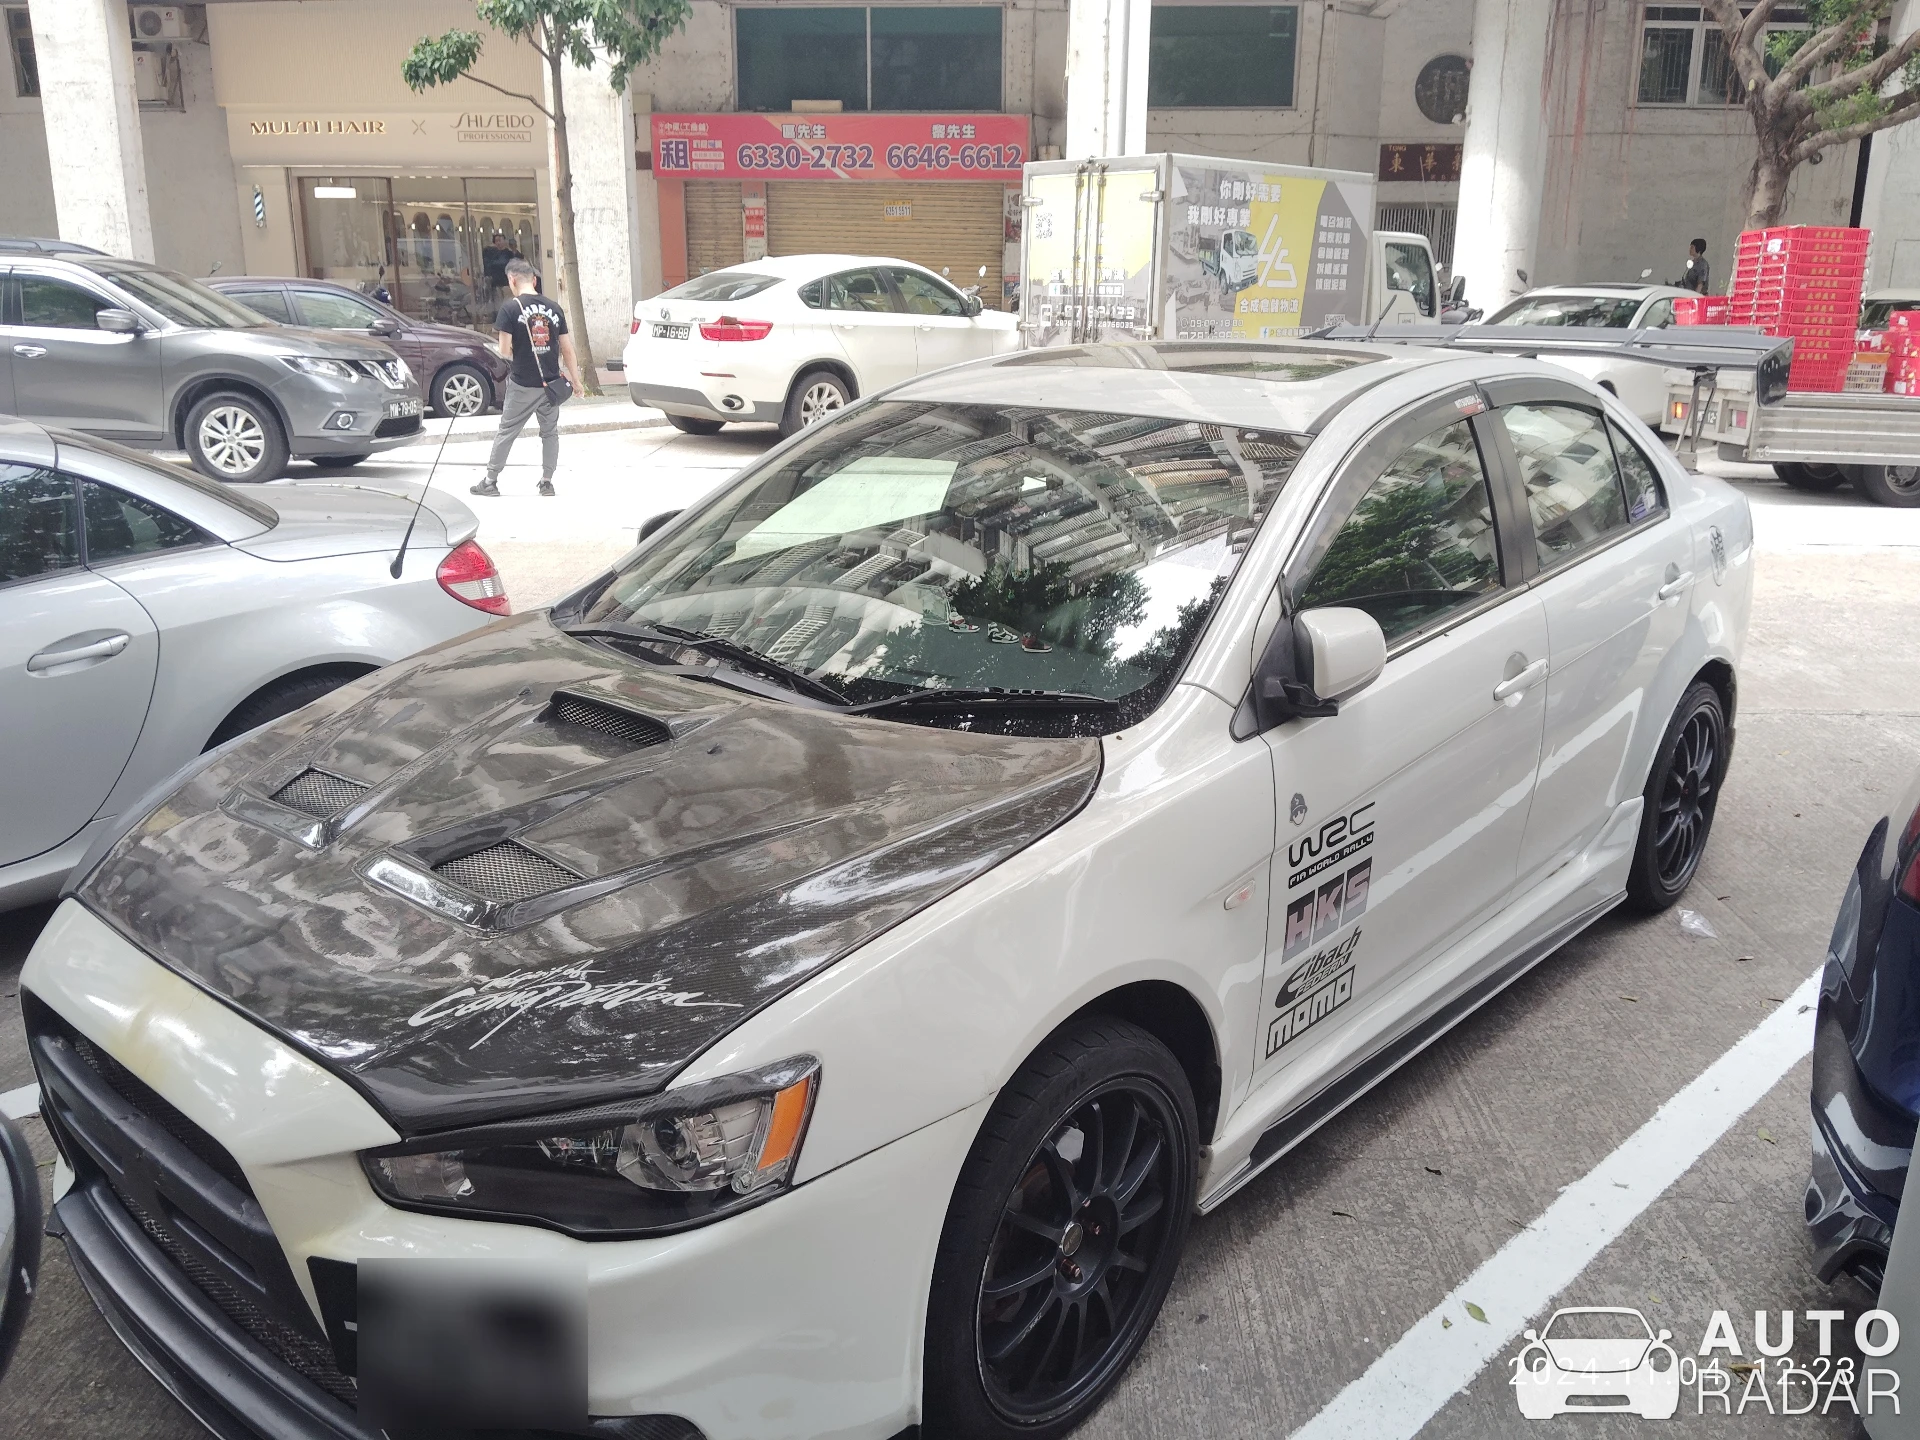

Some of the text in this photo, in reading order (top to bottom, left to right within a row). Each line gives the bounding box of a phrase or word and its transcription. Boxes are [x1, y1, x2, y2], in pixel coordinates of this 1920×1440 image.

[250, 120, 321, 135] MULTI
[327, 120, 387, 135] HAIR
[450, 112, 535, 129] SHISEIDO
[463, 133, 526, 141] PROFESSIONAL
[660, 139, 690, 170] 租
[737, 143, 875, 170] 6330-2732
[886, 143, 1023, 170] 6646-6612
[1220, 180, 1282, 203] 你剛好需要
[1187, 205, 1251, 227] 我剛好專業
[1289, 801, 1376, 868] WRC
[1289, 834, 1373, 887] FIA WORLD RALLY
[1284, 862, 1372, 953] HKS
[1275, 925, 1362, 1008] Eibach
